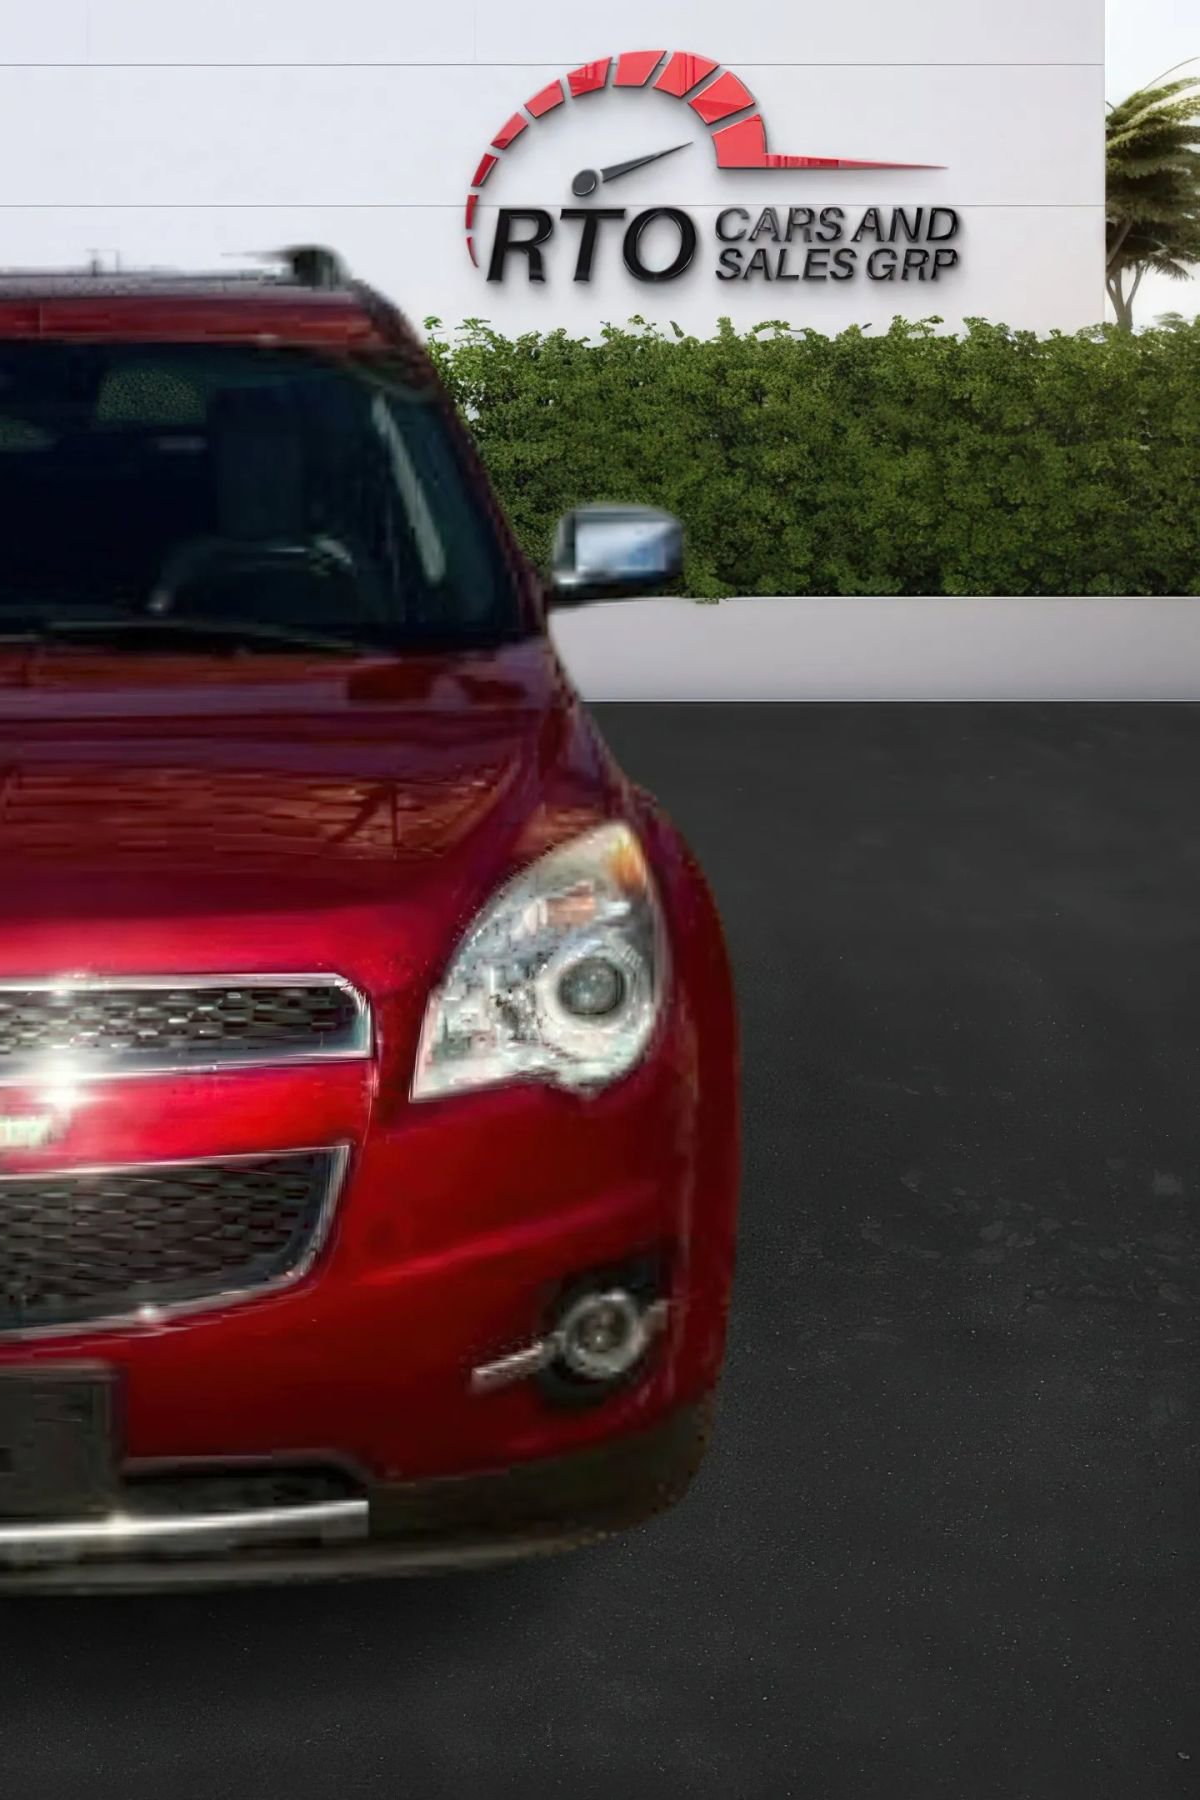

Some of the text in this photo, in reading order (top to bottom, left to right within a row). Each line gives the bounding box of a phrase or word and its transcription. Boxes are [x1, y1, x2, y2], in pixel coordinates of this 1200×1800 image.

[715, 206, 960, 243] CARS AND
[487, 206, 697, 283] RTO
[715, 247, 959, 282] SALES GRP
